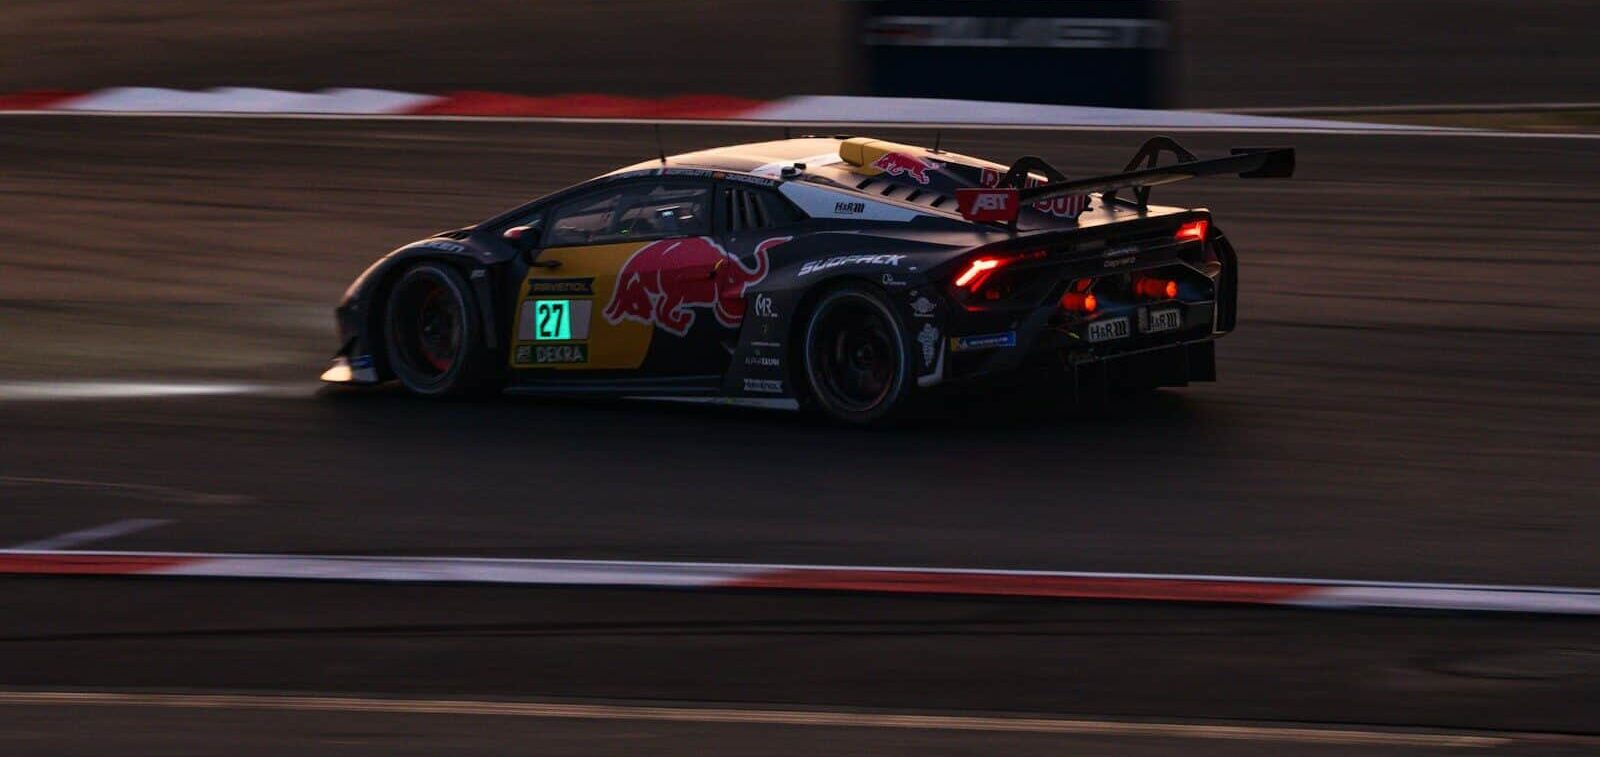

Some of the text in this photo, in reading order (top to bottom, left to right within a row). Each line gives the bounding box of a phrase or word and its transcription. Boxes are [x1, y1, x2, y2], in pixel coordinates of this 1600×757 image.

[971, 193, 1009, 216] ABT
[539, 303, 563, 337] 27
[536, 345, 585, 363] DEKRA
